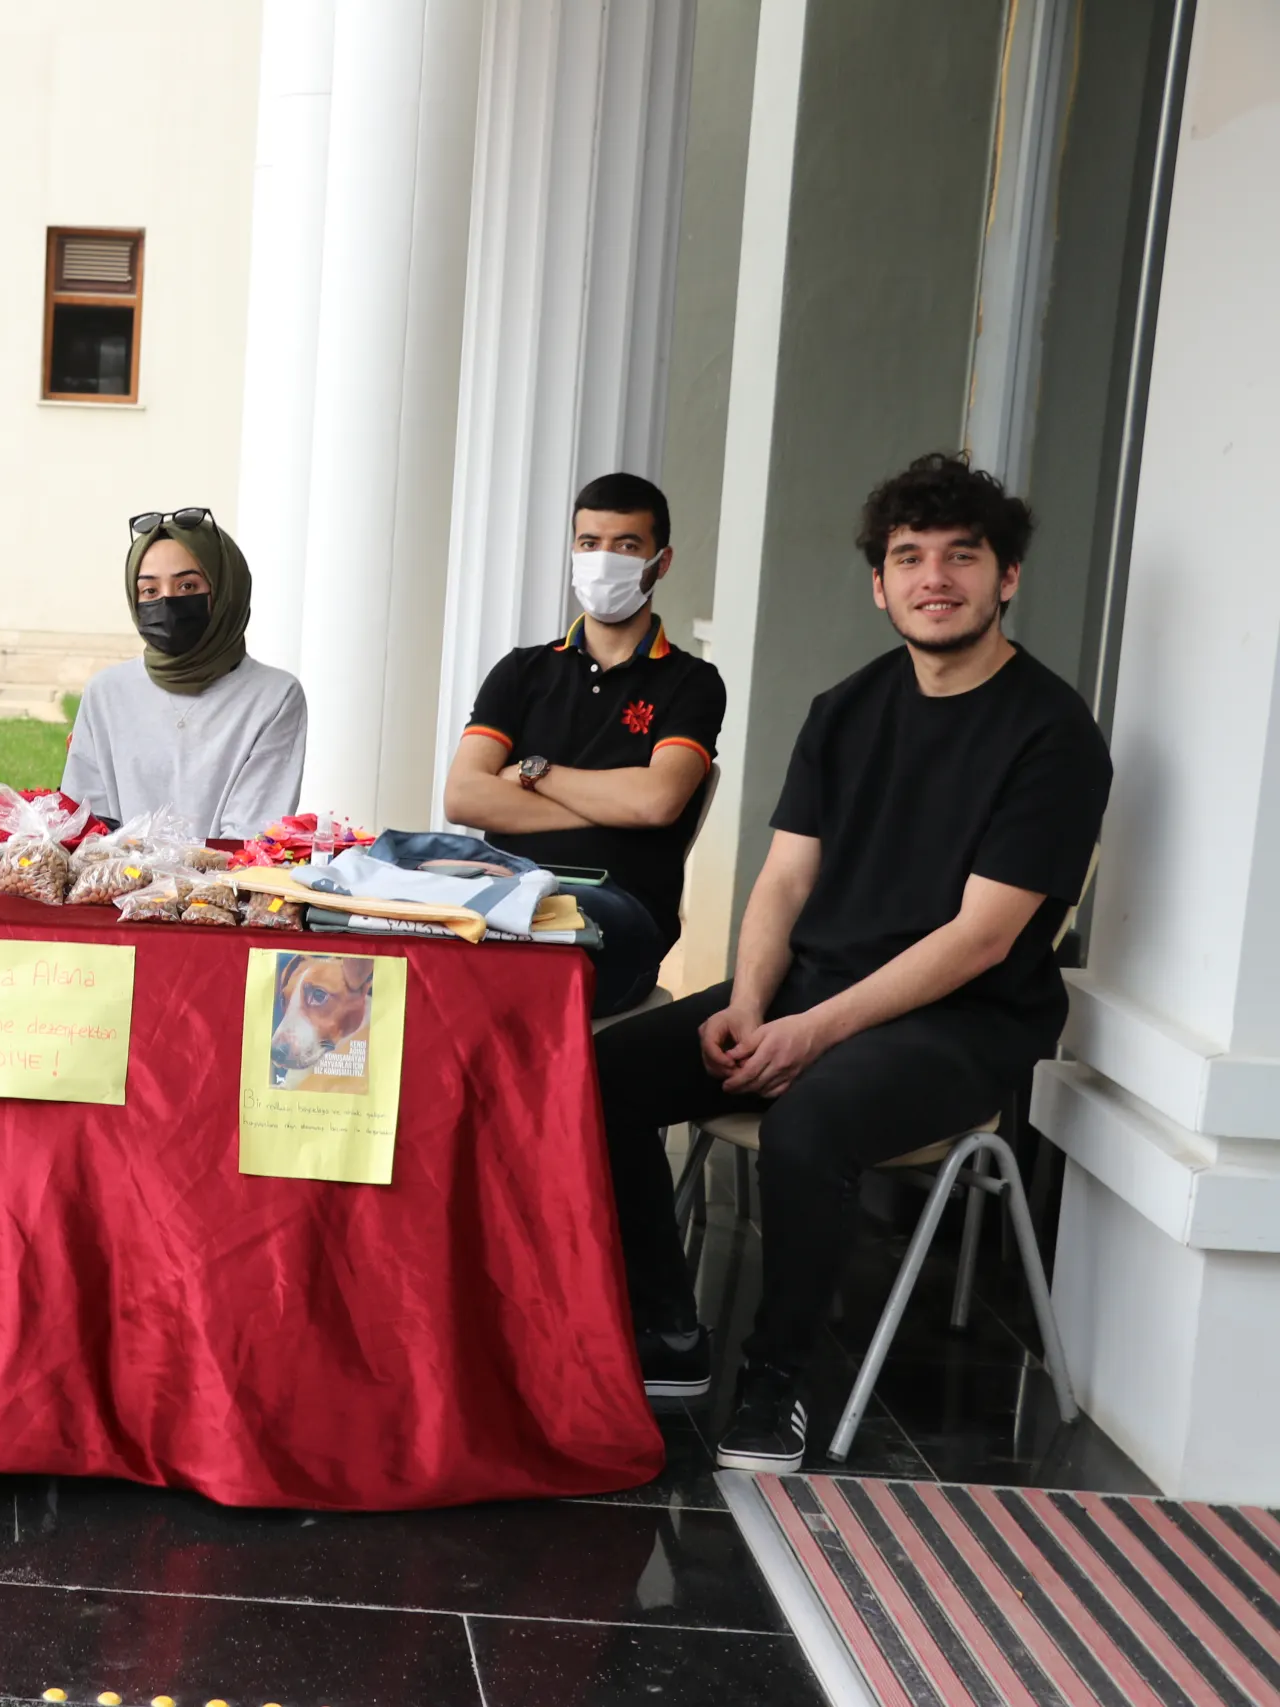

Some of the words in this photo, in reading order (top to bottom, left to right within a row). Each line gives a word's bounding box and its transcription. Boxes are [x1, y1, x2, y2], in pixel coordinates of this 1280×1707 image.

[33, 959, 95, 987] Alana
[26, 1016, 118, 1045] dezenfektan
[243, 1088, 261, 1108] Bir
